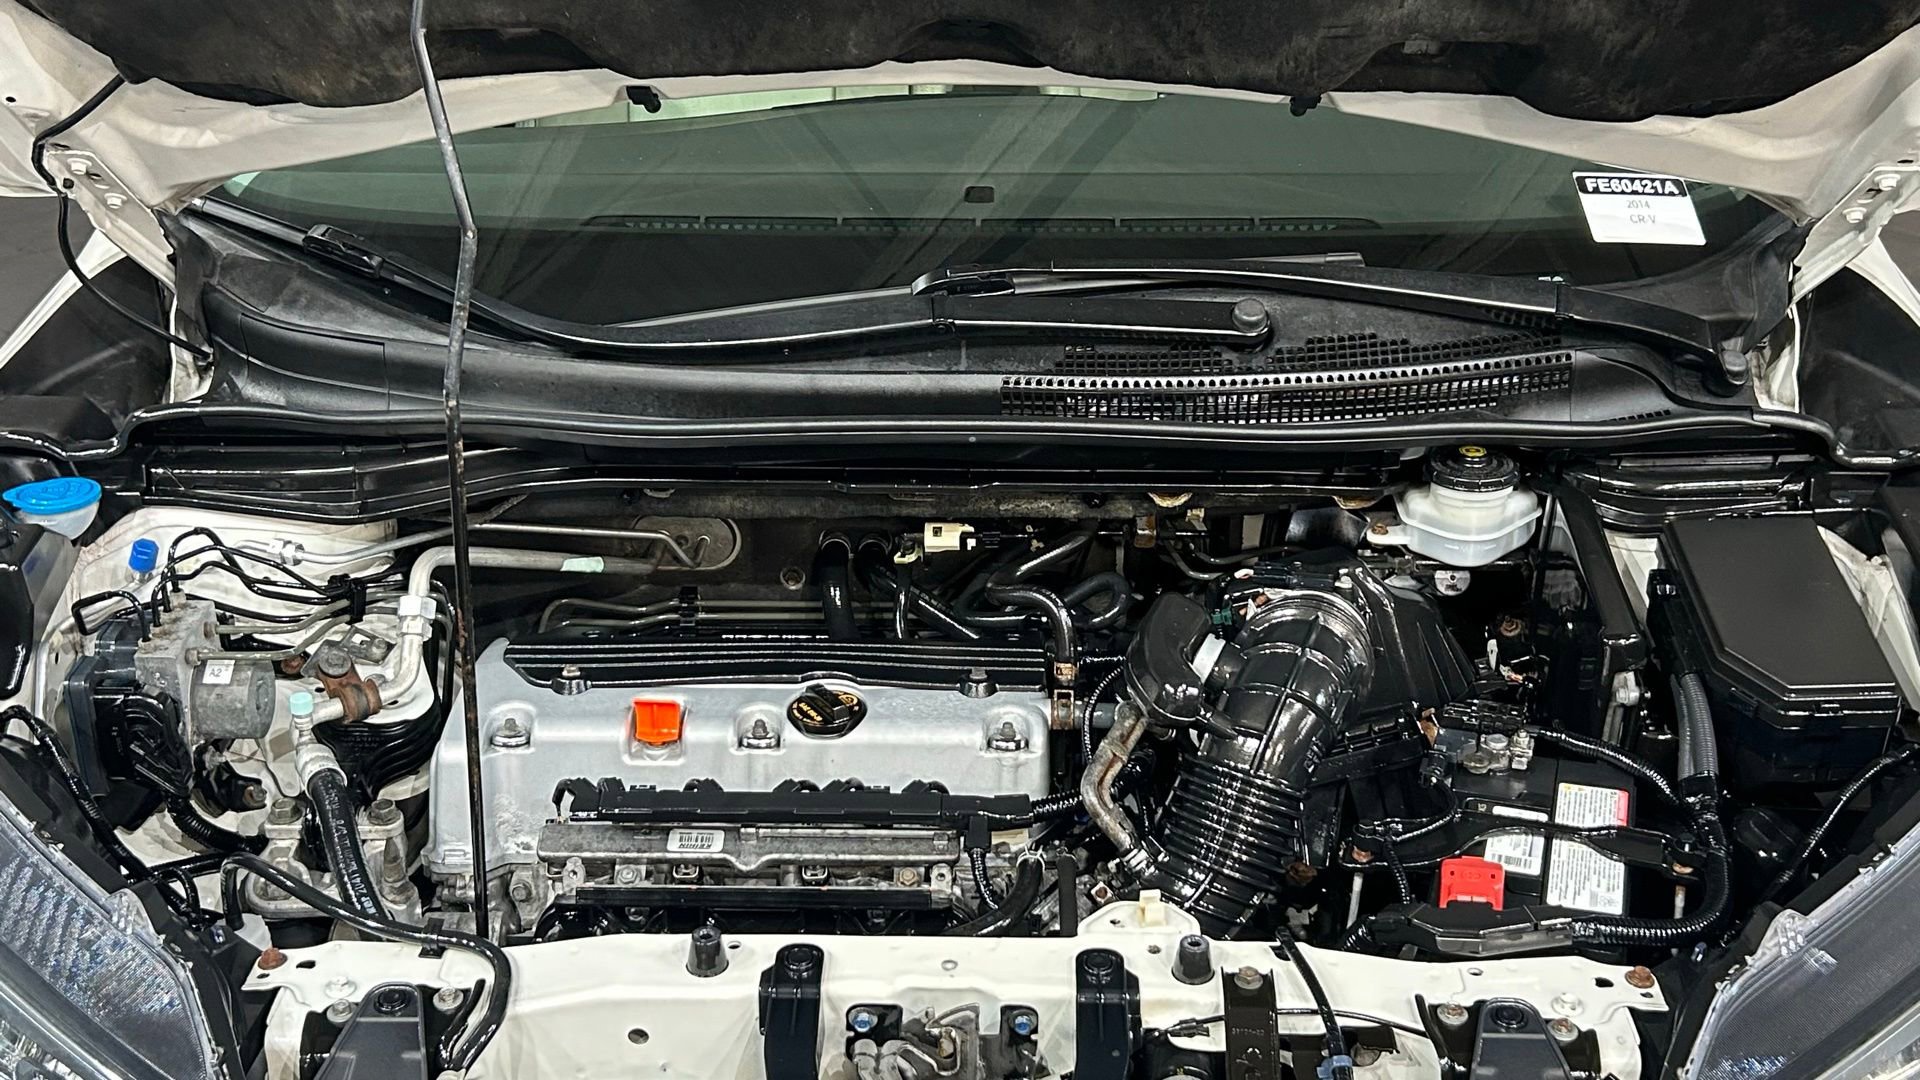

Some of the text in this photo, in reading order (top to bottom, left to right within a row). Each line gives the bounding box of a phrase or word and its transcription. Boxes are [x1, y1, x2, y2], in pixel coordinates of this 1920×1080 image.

[1585, 178, 1680, 194] FE60421A
[1627, 199, 1650, 209] 2014
[1630, 214, 1656, 224] CR-V
[209, 668, 223, 678] A2
